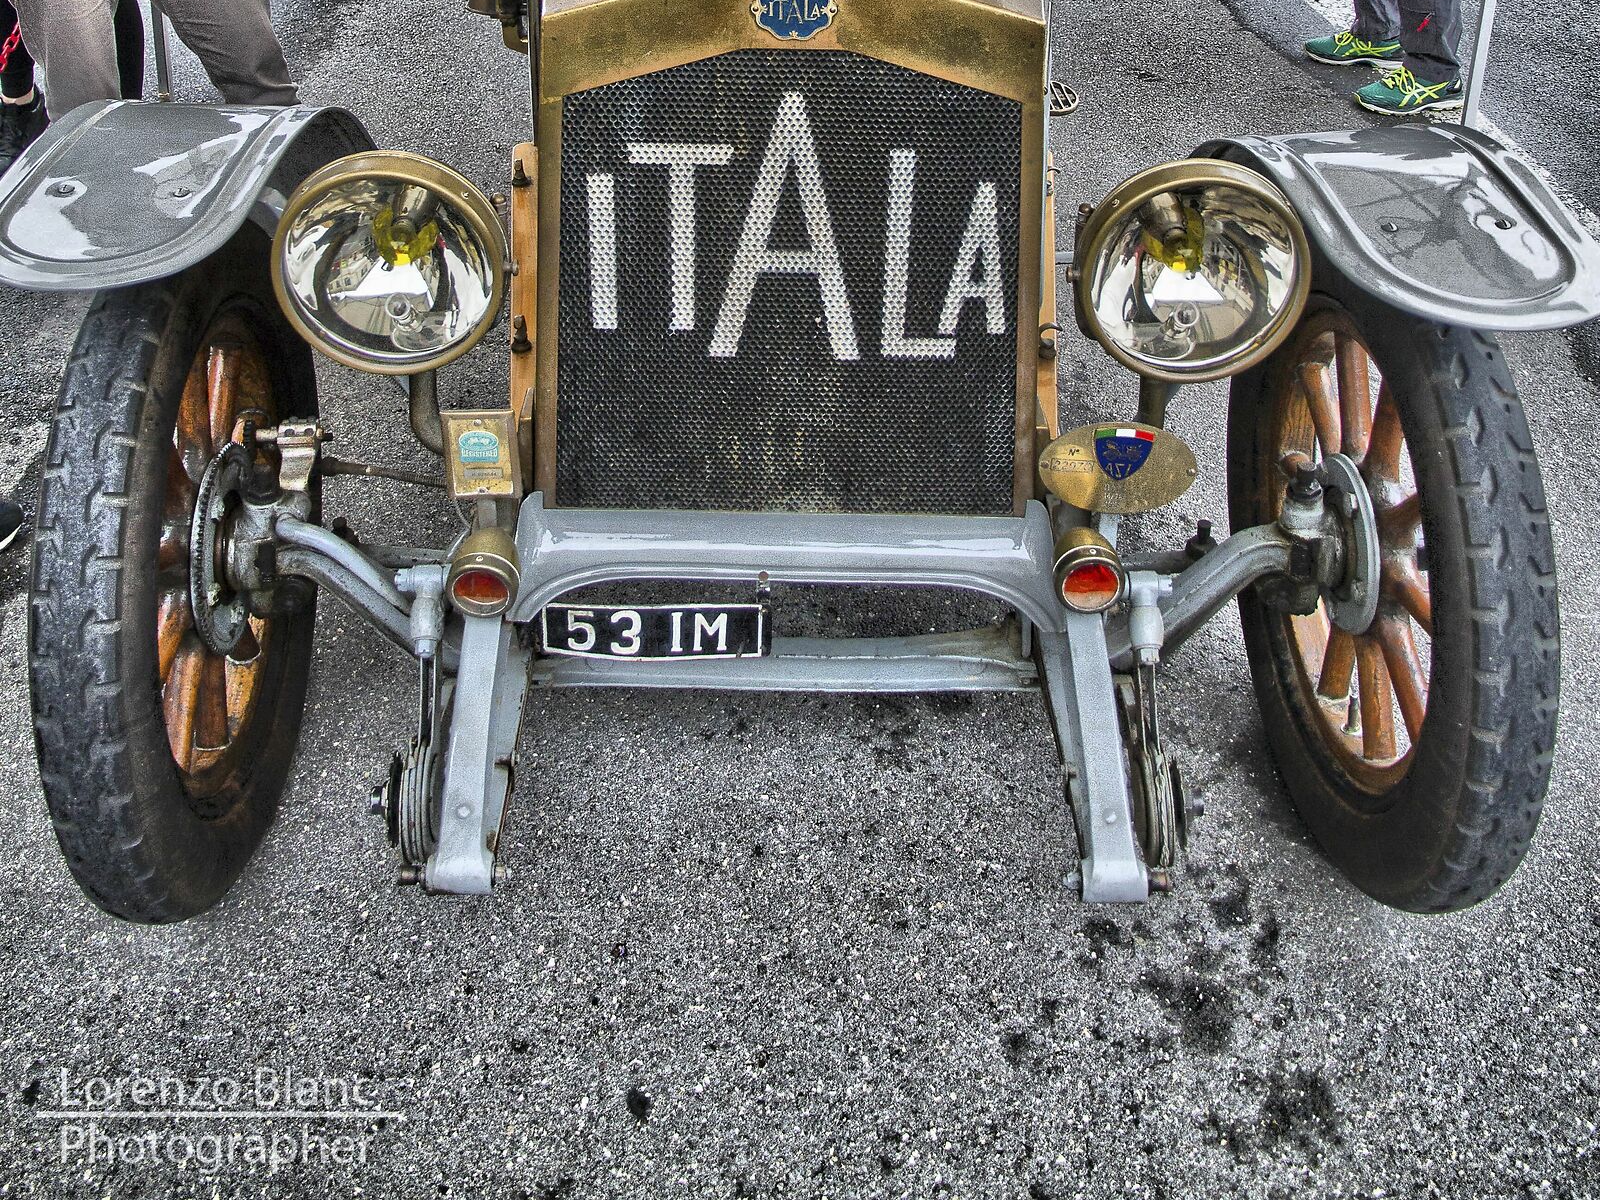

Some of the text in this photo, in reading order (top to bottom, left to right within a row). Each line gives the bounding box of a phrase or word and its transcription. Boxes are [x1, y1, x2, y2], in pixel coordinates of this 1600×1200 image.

[586, 91, 1006, 361] ITALA
[567, 610, 728, 655] 53 IM
